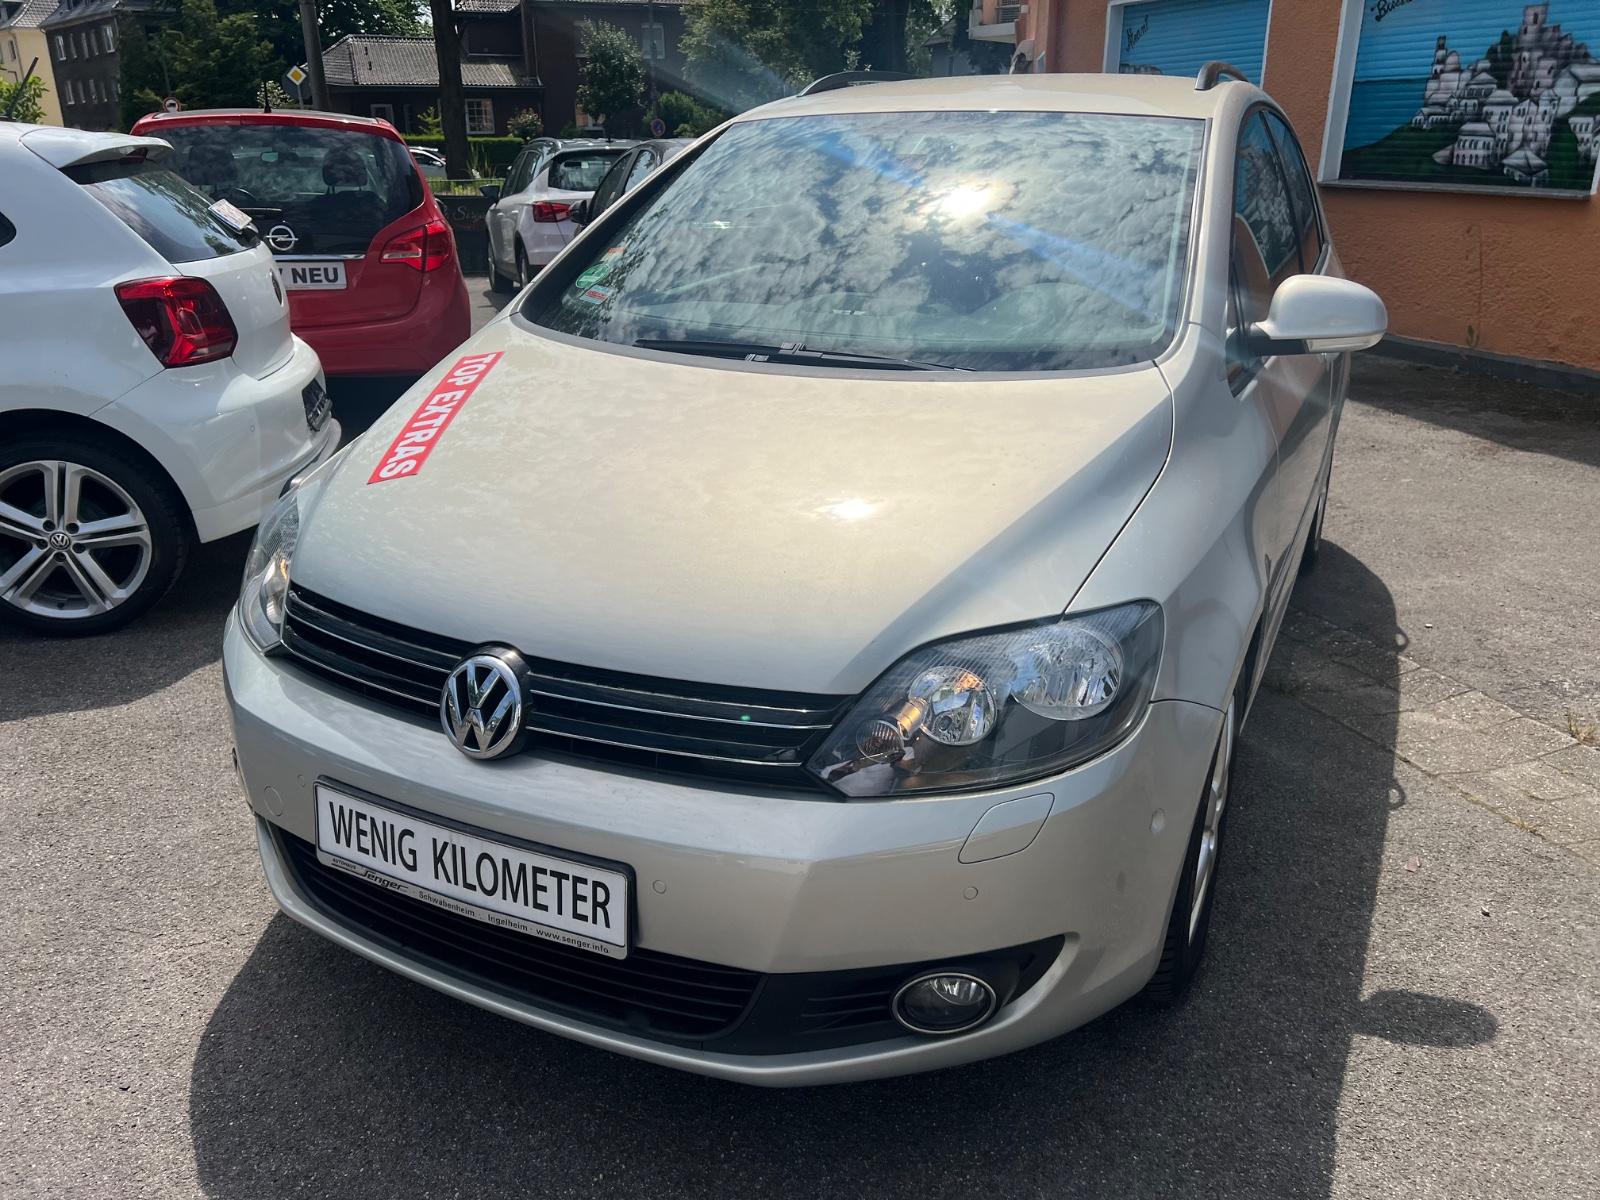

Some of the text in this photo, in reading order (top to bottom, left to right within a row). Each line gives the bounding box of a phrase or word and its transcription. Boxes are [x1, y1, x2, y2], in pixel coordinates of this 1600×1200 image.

[291, 267, 339, 284] NEU
[379, 353, 496, 478] TOP EXTRAS
[445, 658, 517, 755] VW
[329, 801, 611, 929] WENIG KILOMETER
[418, 890, 609, 954] Schwabenheim Ingelheim www.senger.info
